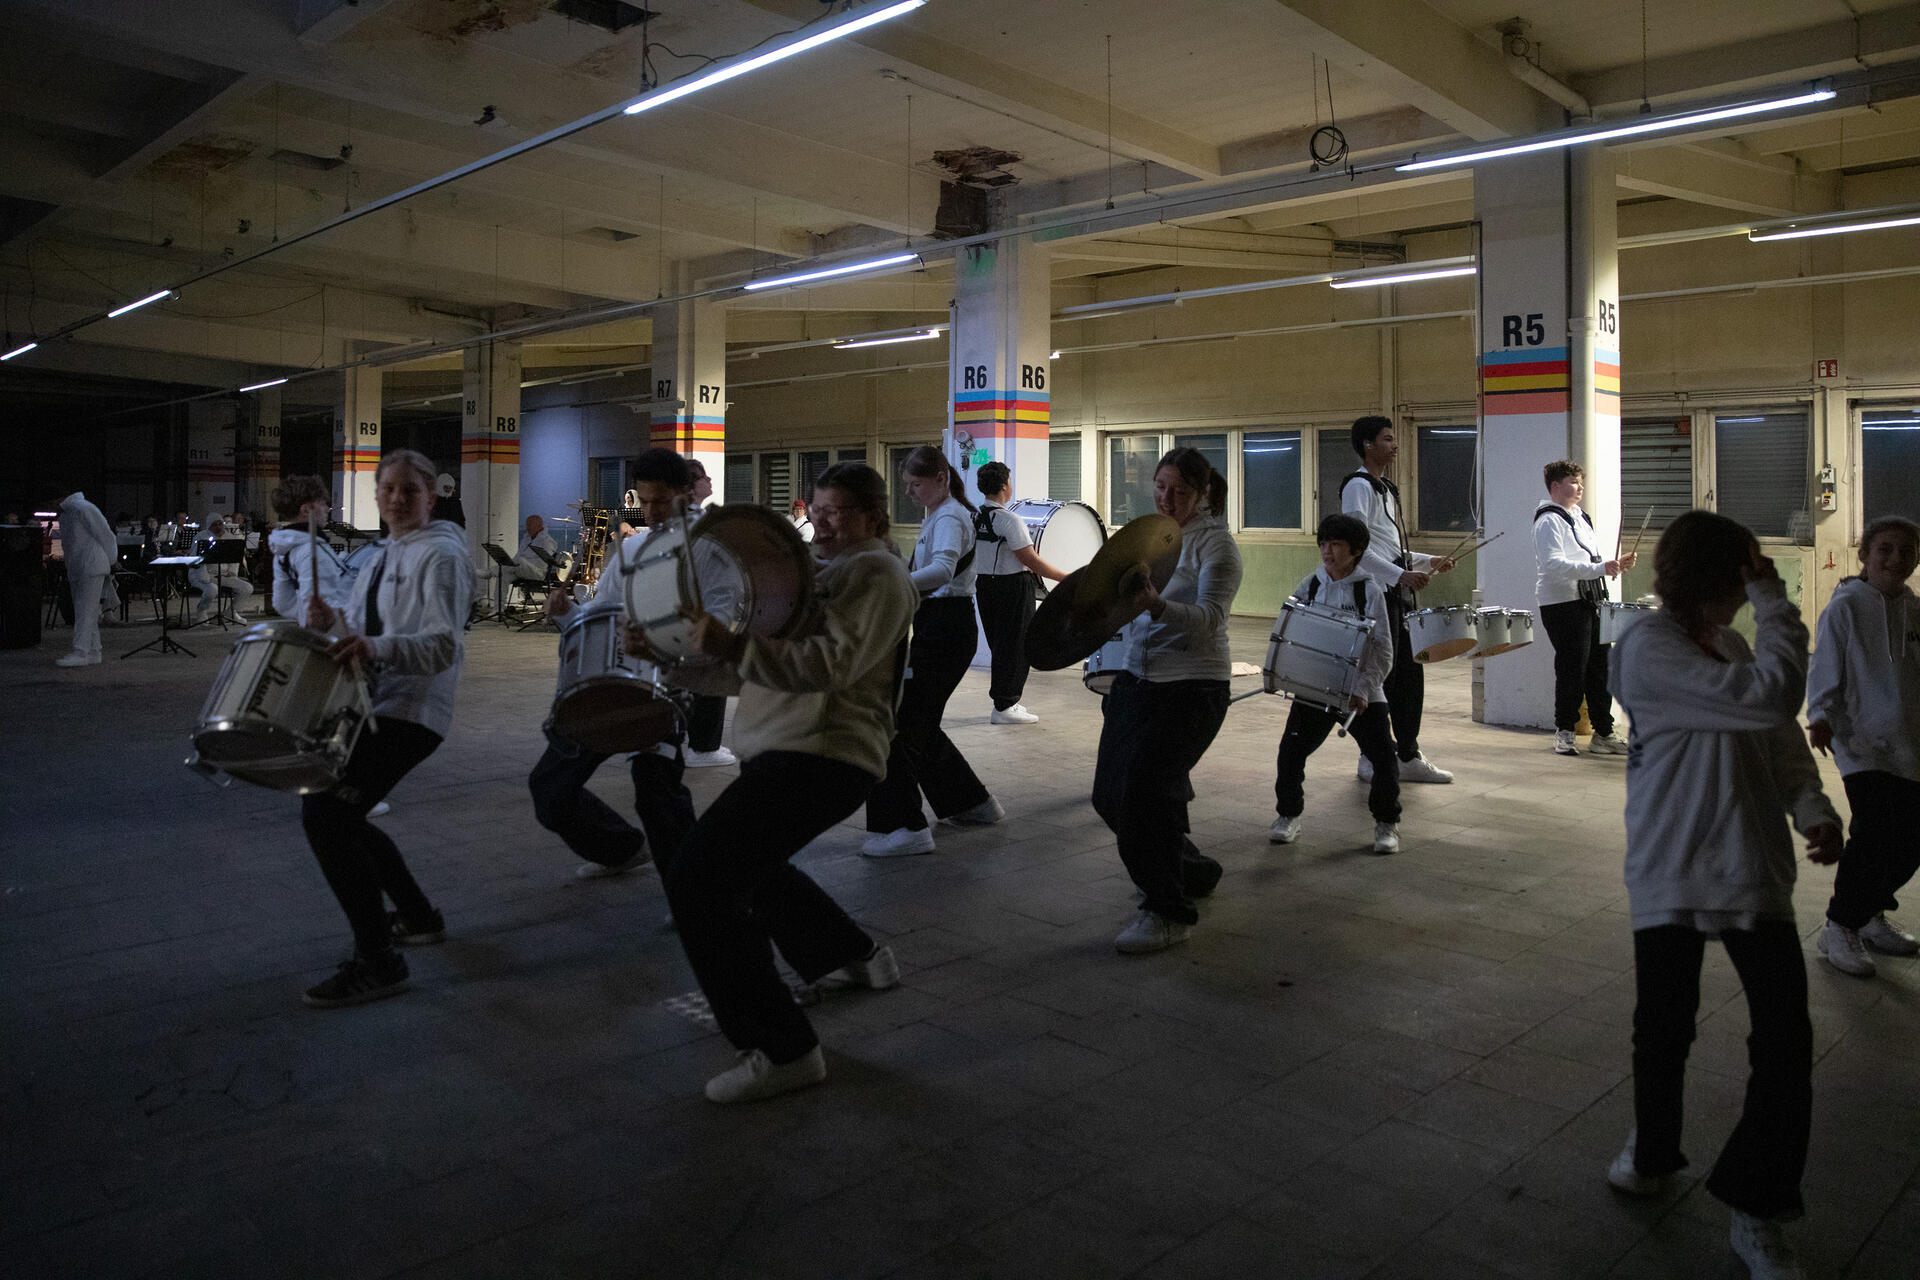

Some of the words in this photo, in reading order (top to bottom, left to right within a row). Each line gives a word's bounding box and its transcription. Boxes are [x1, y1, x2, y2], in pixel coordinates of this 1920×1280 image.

[1600, 300, 1616, 334] R5
[1503, 315, 1545, 346] R5
[964, 366, 987, 389] R6
[1022, 365, 1045, 389] R6
[658, 380, 672, 398] R7
[699, 385, 720, 404] R7
[466, 400, 476, 416] R8
[360, 422, 377, 435] R9
[497, 417, 516, 433] R8
